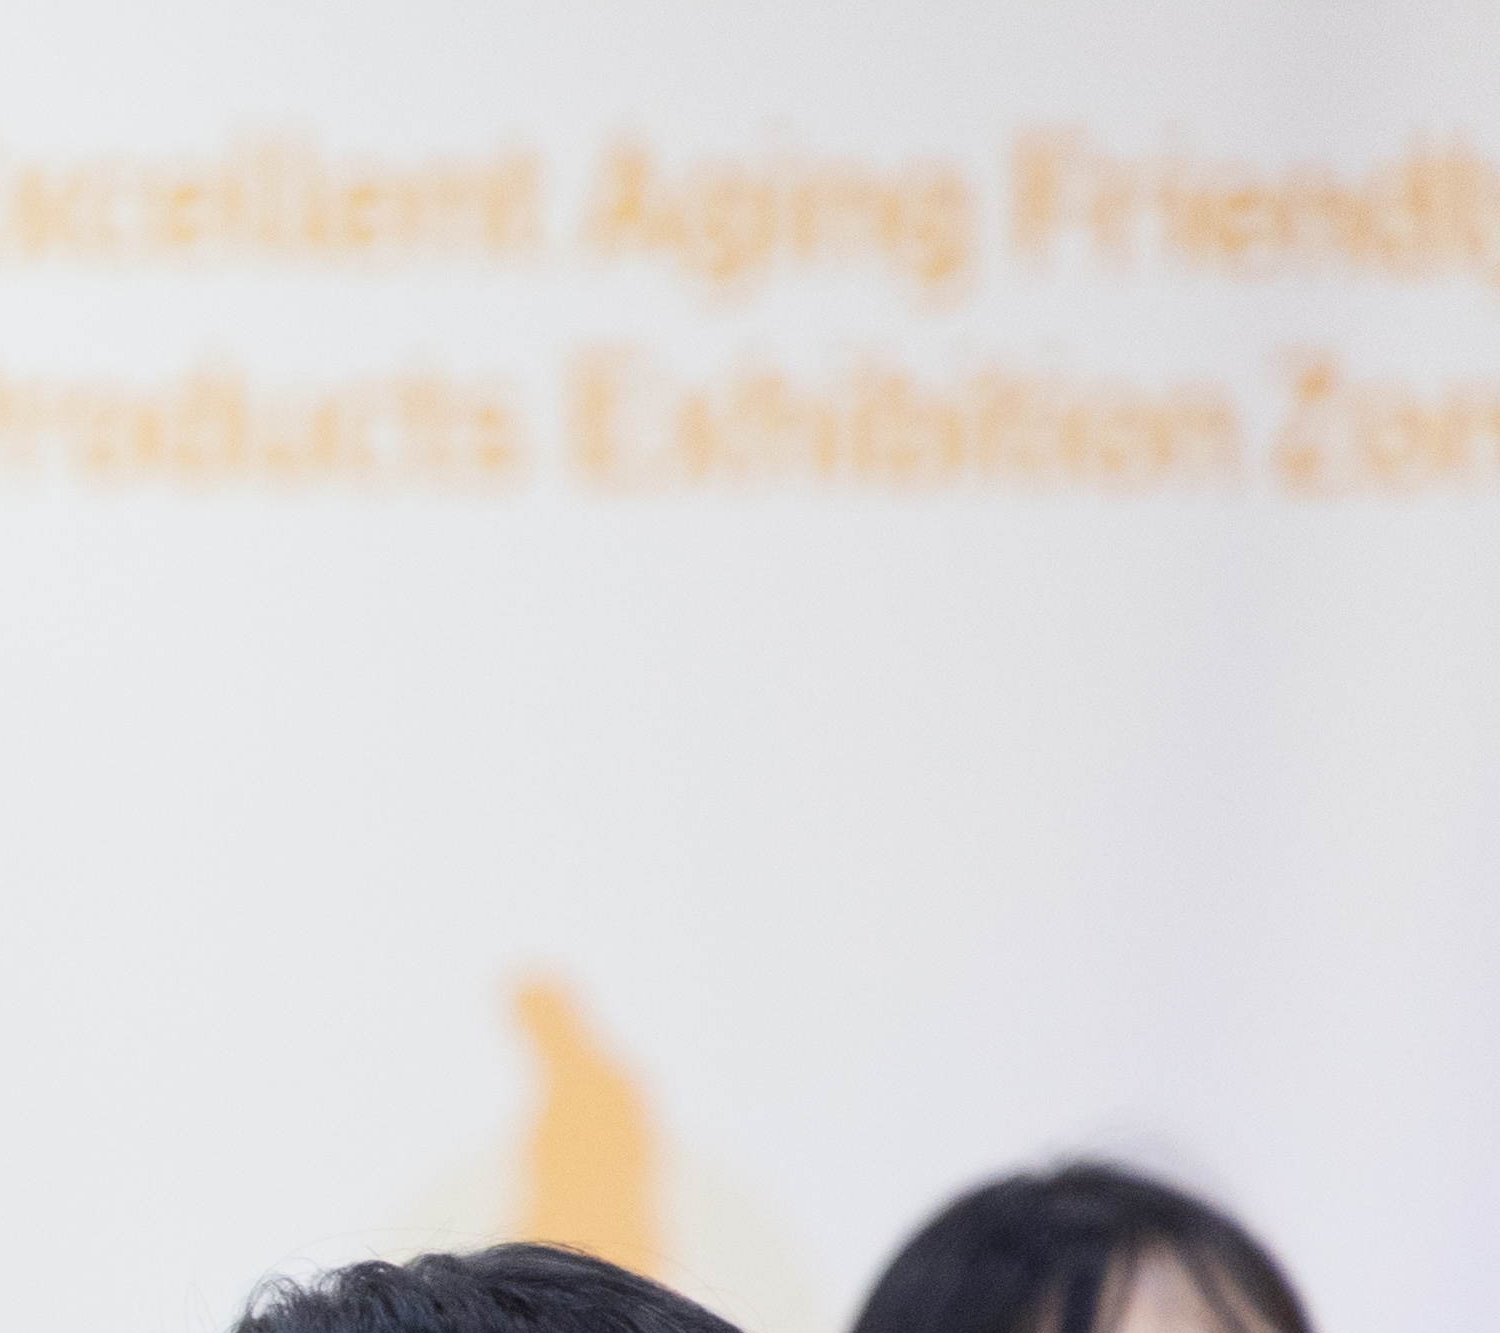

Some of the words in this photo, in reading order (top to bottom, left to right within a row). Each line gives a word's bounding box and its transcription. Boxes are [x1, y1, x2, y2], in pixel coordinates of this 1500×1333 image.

[580, 128, 982, 312] Aging
[1006, 126, 1500, 300] Friendl
[560, 347, 1248, 498] Exhibition
